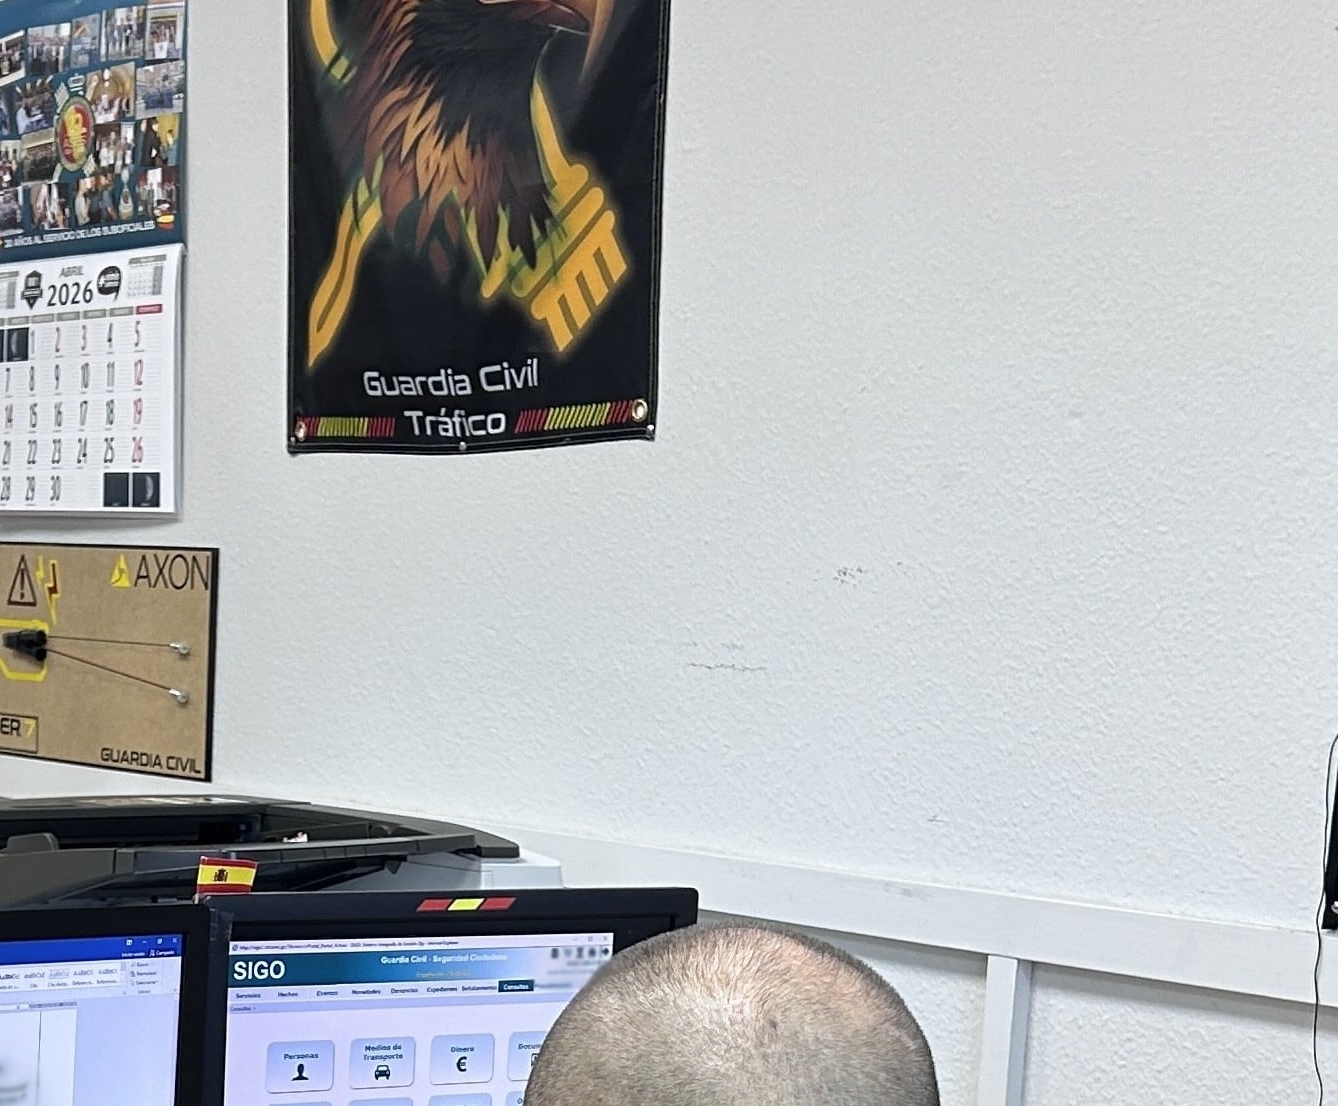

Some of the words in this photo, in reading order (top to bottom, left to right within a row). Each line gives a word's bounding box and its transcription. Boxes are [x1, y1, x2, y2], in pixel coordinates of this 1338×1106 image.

[59, 265, 85, 278] ABRIL
[47, 280, 94, 307] 2026
[362, 368, 472, 397] Guardia
[479, 357, 540, 393] Civil
[403, 408, 507, 438] Tráfico
[134, 553, 210, 591] AXON
[24, 717, 37, 739] 7
[100, 747, 163, 770] GUARDIA
[166, 756, 202, 775] CIVIL
[380, 956, 410, 964] Guardia
[411, 955, 428, 963] Civil
[433, 954, 468, 964] Seguridad
[233, 960, 286, 981] SIGO
[363, 1053, 404, 1062] Transporte
[364, 1044, 391, 1052] Medios
[392, 1043, 402, 1051] de
